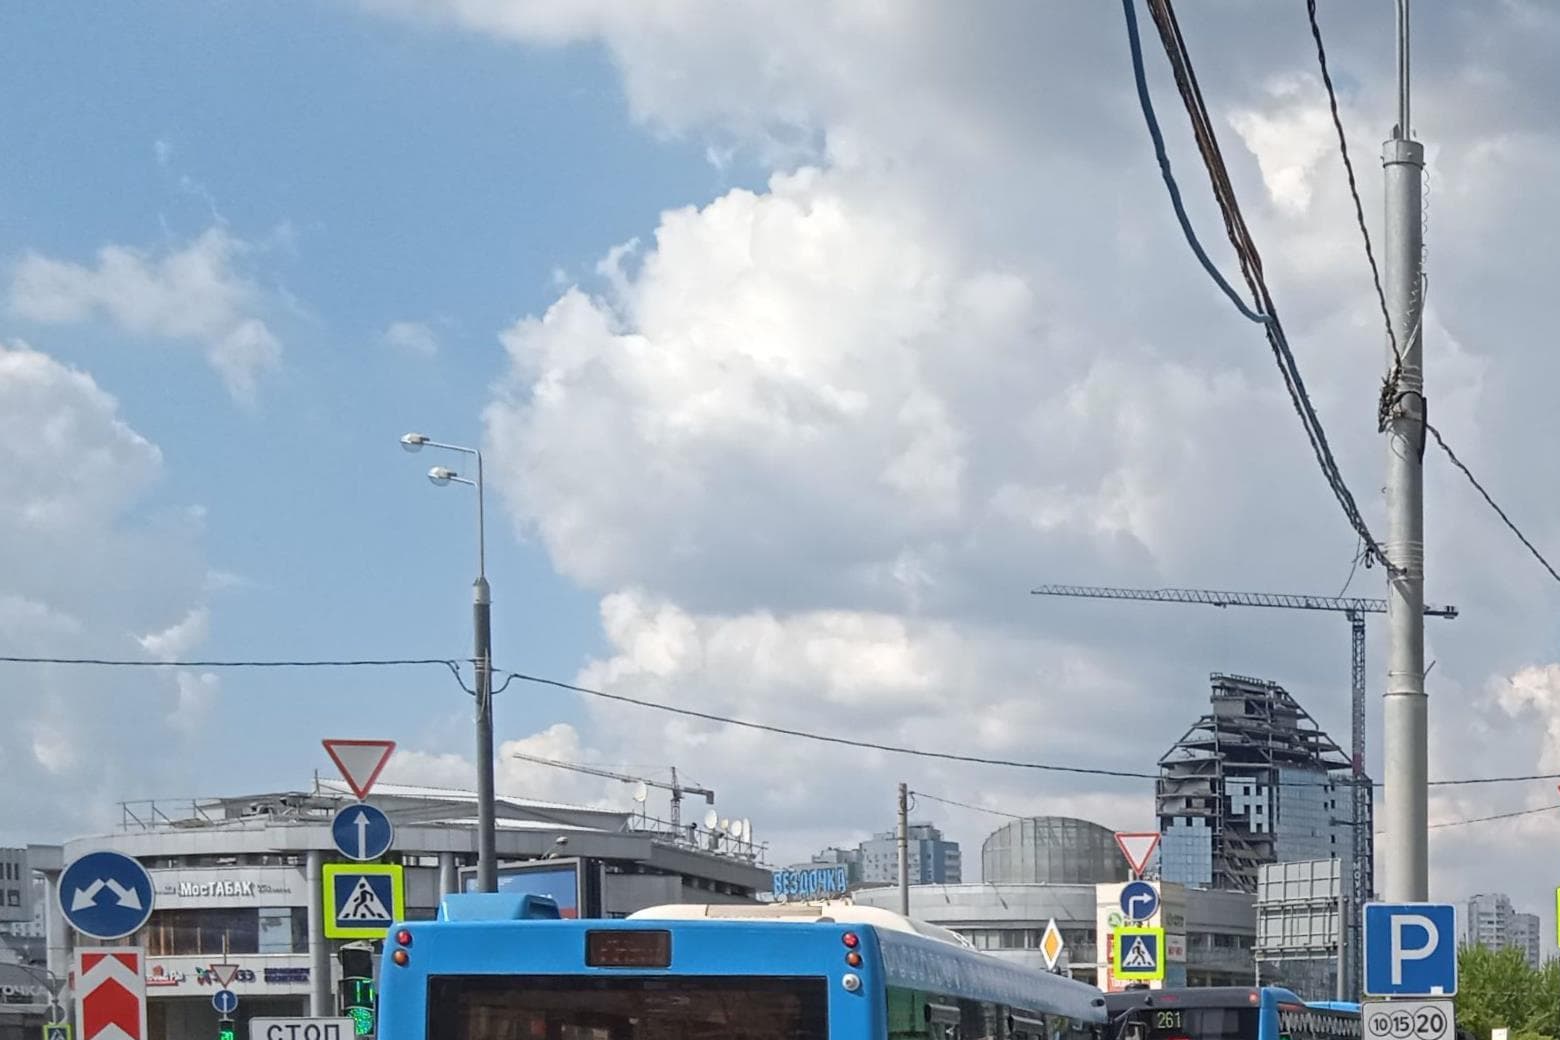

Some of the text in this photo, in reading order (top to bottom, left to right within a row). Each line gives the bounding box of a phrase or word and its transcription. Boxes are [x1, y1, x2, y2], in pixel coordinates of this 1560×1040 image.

[1391, 914, 1439, 985] P
[1157, 1011, 1181, 1028] 261
[1374, 1014, 1443, 1033] 10 15 20
